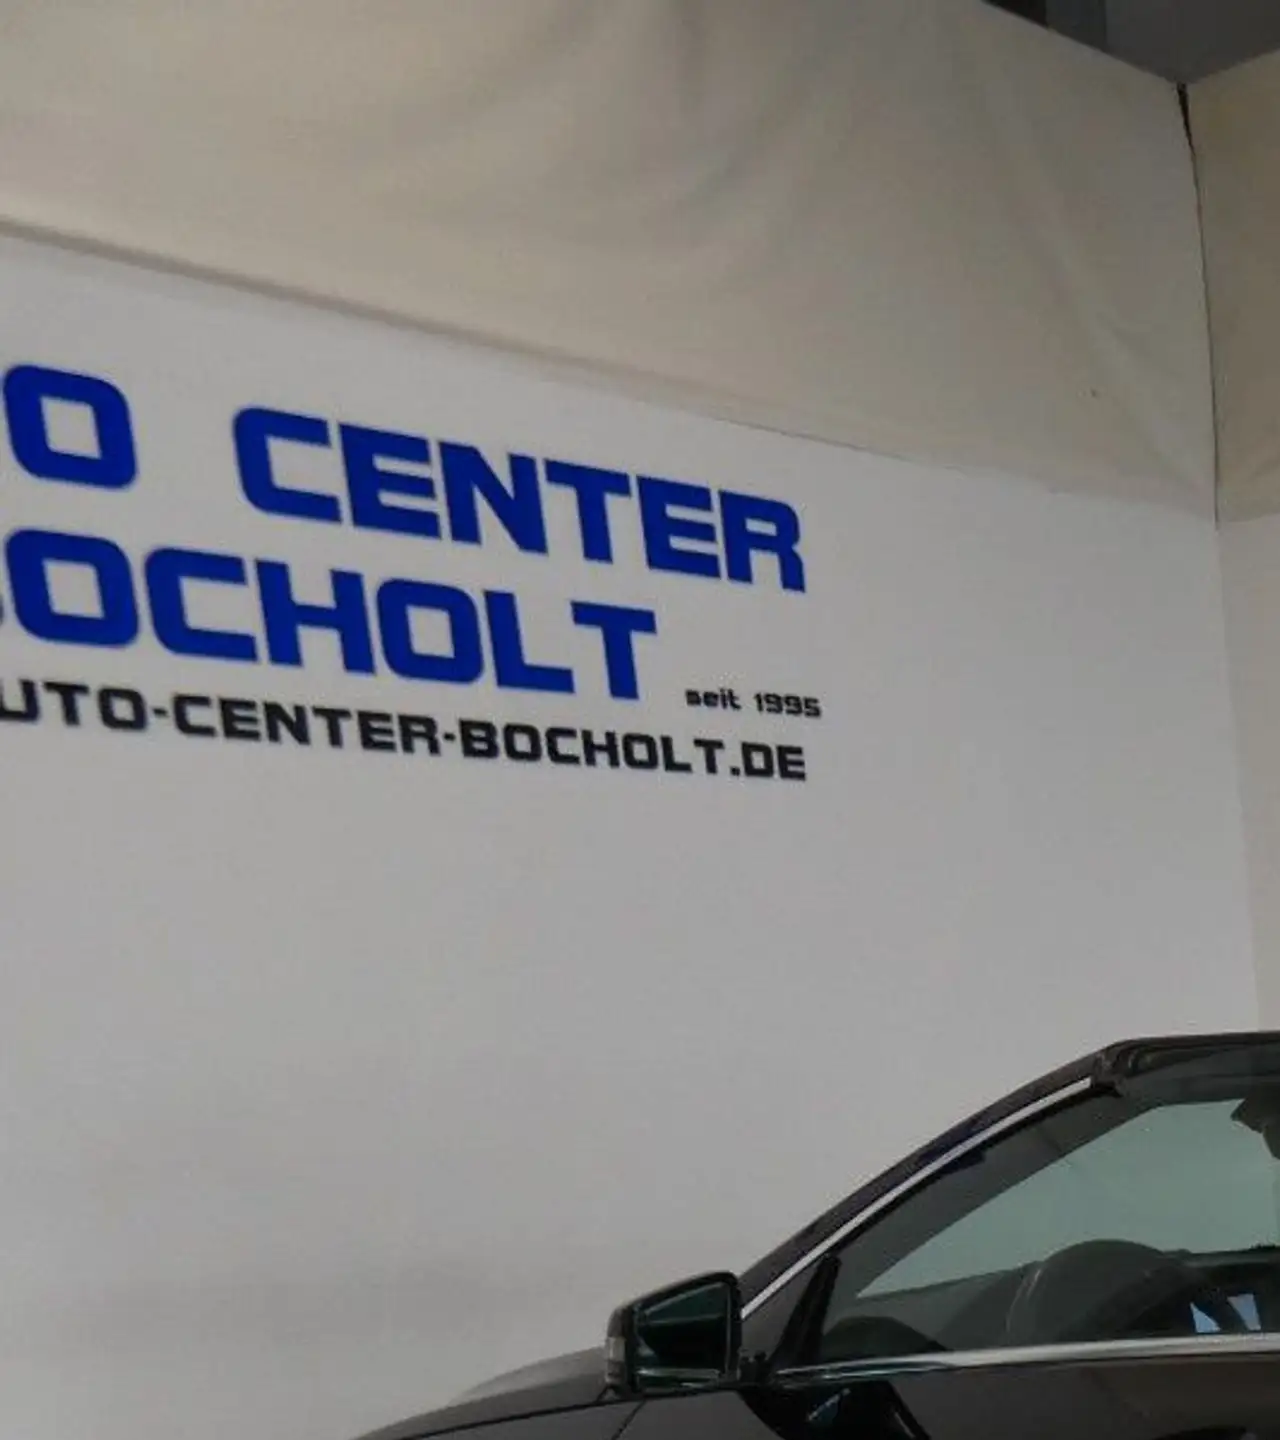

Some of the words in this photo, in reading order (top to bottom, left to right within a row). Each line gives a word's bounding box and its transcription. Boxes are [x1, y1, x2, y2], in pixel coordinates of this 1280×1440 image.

[233, 406, 806, 592] CENTER
[0, 527, 657, 701] OCHOLT
[685, 687, 742, 711] seit
[753, 692, 822, 719] 1995
